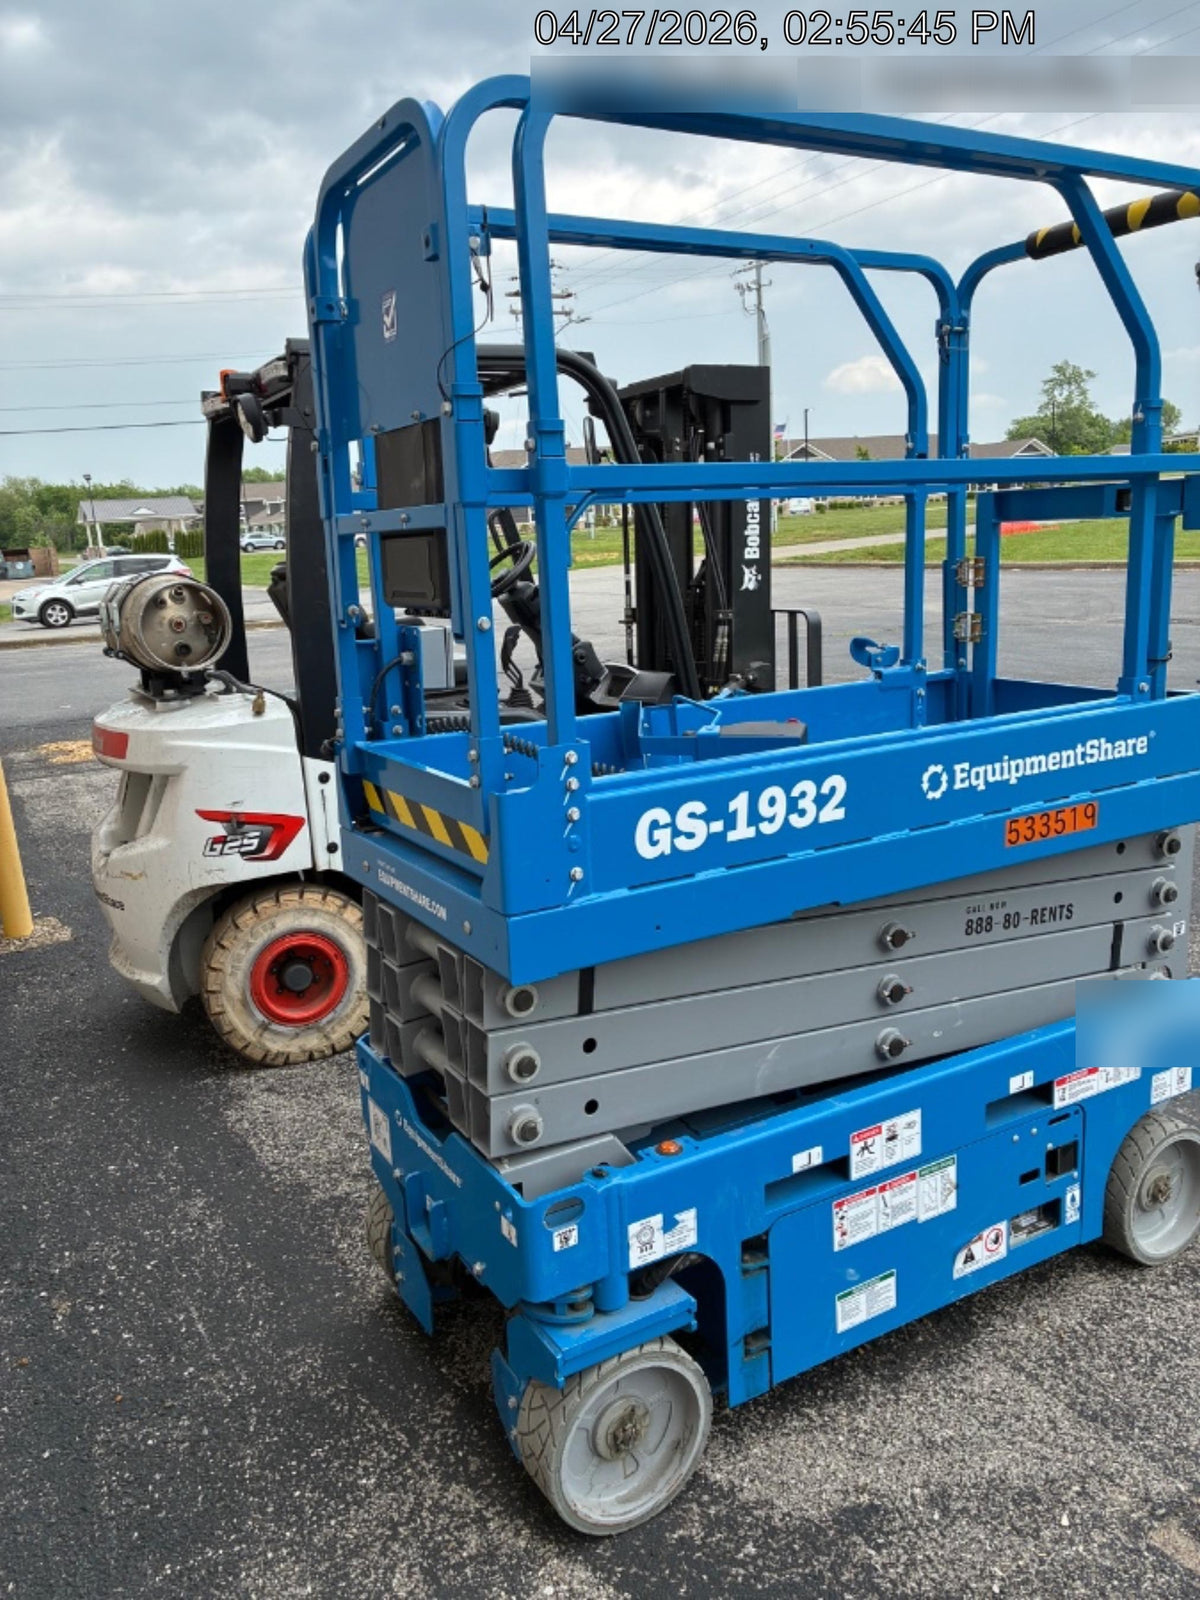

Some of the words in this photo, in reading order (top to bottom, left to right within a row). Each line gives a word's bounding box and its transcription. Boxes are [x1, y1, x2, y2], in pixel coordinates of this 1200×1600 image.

[744, 498, 760, 560] Bobca
[953, 735, 1149, 791] EquipmentShare
[634, 774, 848, 860] GS-1932
[1007, 802, 1097, 846] 533519
[964, 902, 1075, 936] 888-80-RENTS
